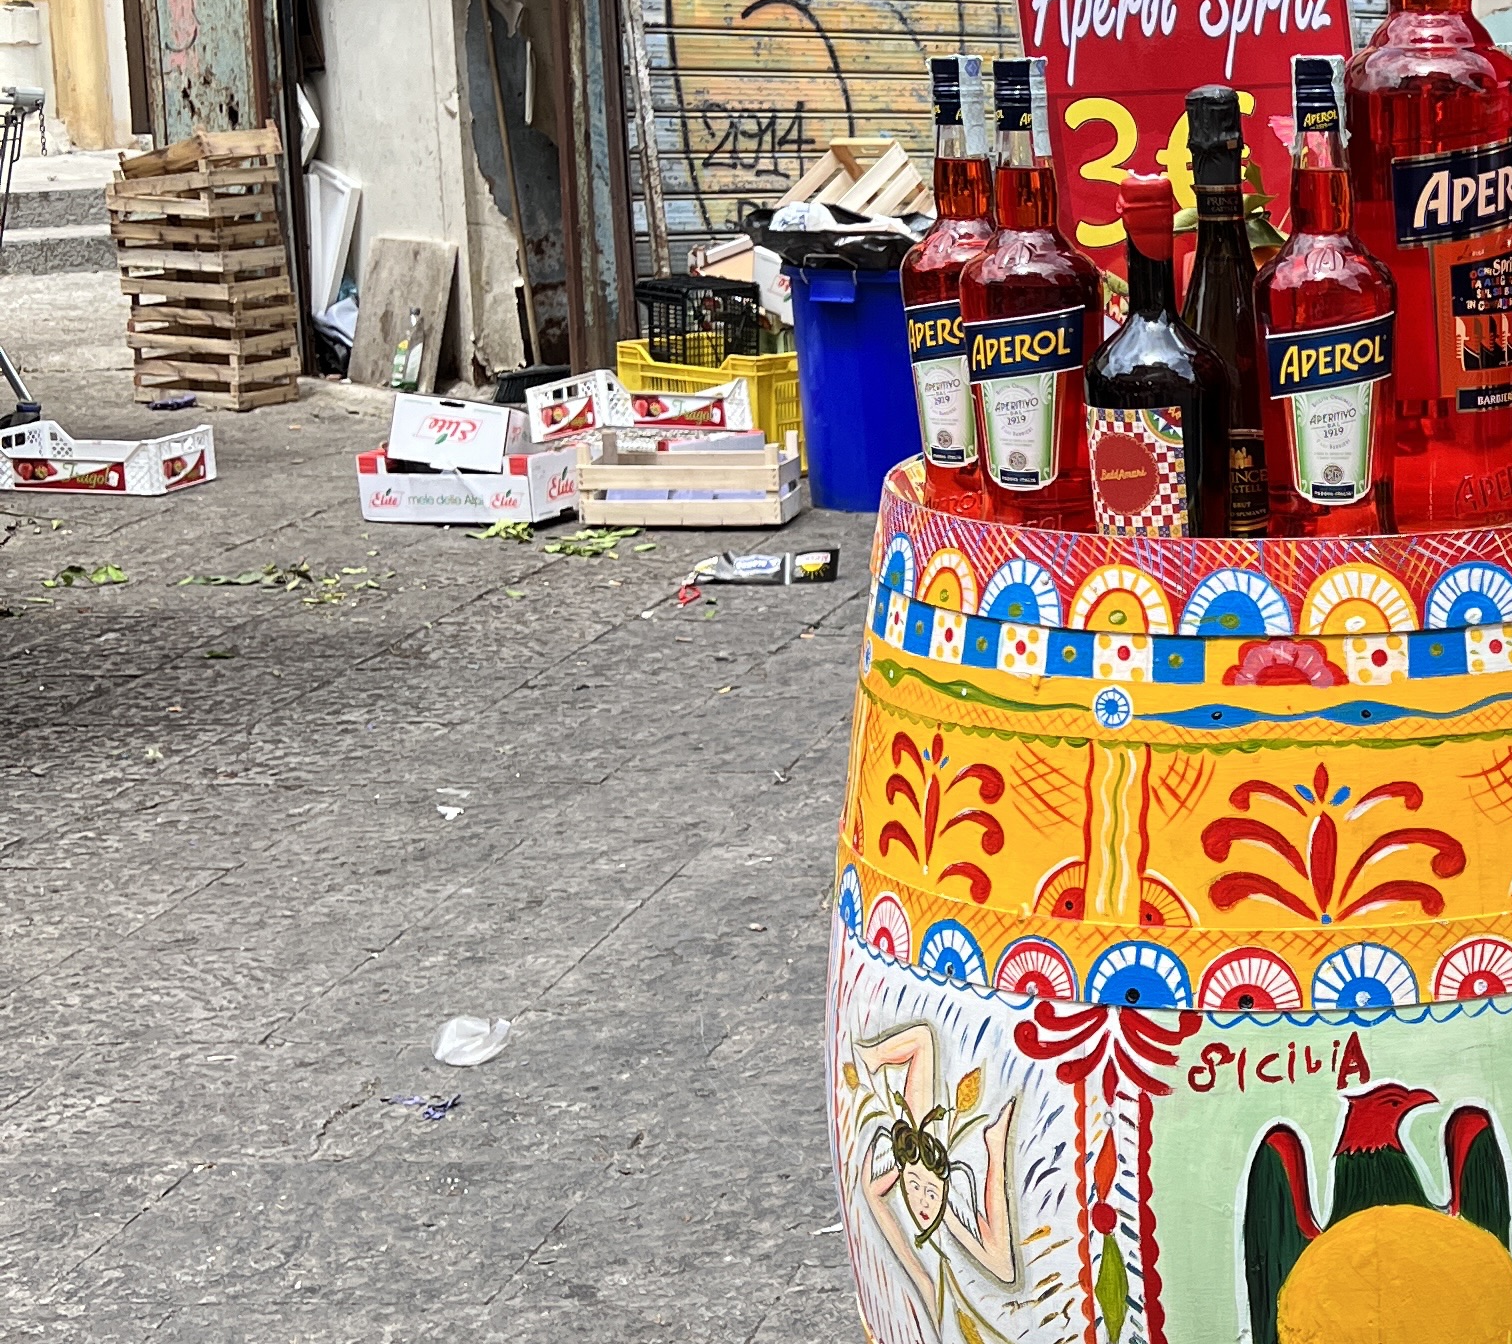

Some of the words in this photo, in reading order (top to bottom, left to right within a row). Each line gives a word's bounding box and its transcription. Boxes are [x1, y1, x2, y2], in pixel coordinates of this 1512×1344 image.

[908, 316, 965, 353] APERO
[972, 327, 1071, 372] APEROL
[1279, 335, 1385, 385] APEROL
[994, 397, 1039, 413] APERITIVO
[1007, 415, 1026, 426] 1919
[1309, 407, 1357, 426] APERITIVO
[1323, 426, 1345, 439] 1919
[1231, 469, 1268, 484] INCE
